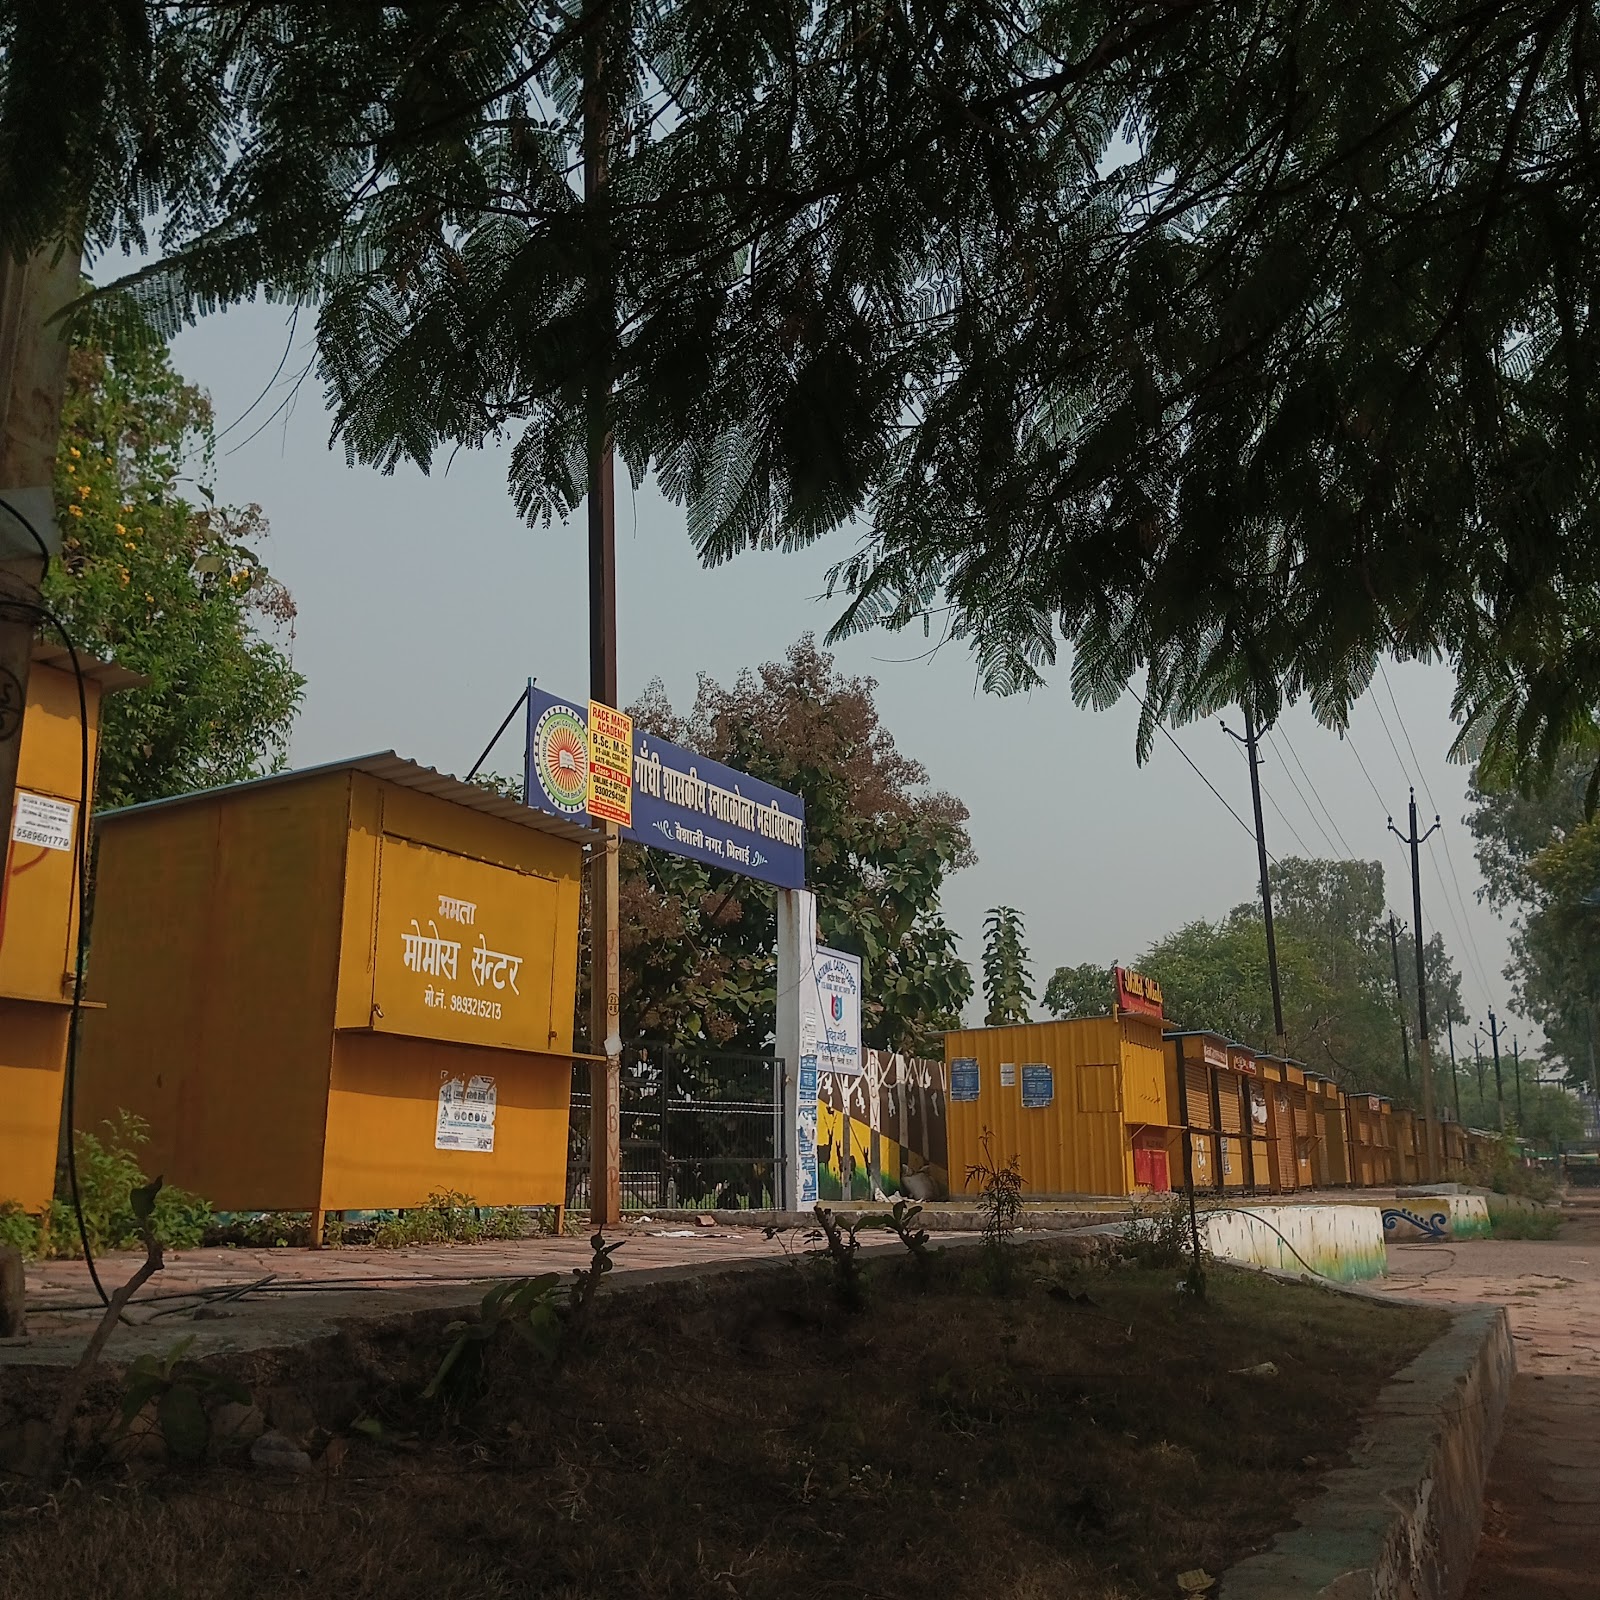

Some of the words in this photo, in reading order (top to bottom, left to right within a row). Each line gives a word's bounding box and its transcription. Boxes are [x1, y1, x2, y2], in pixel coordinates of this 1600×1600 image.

[593, 707, 610, 722] RACE
[611, 714, 630, 732] MATHS
[597, 721, 627, 742] ACADEMY
[593, 733, 611, 750] B.Sc.
[613, 741, 630, 758] M.Sc.
[663, 767, 707, 814] शासकीय
[708, 784, 756, 832] स्नातकोत्तर
[756, 800, 803, 849] महाविद्यालय
[674, 822, 704, 848] वैशाली
[705, 834, 724, 858] नगर,
[726, 840, 750, 865] भिलाई
[438, 895, 477, 925] ममता
[401, 919, 461, 980] मोमोस
[472, 933, 523, 995] सेन्टर
[450, 995, 502, 1020] 9893215213
